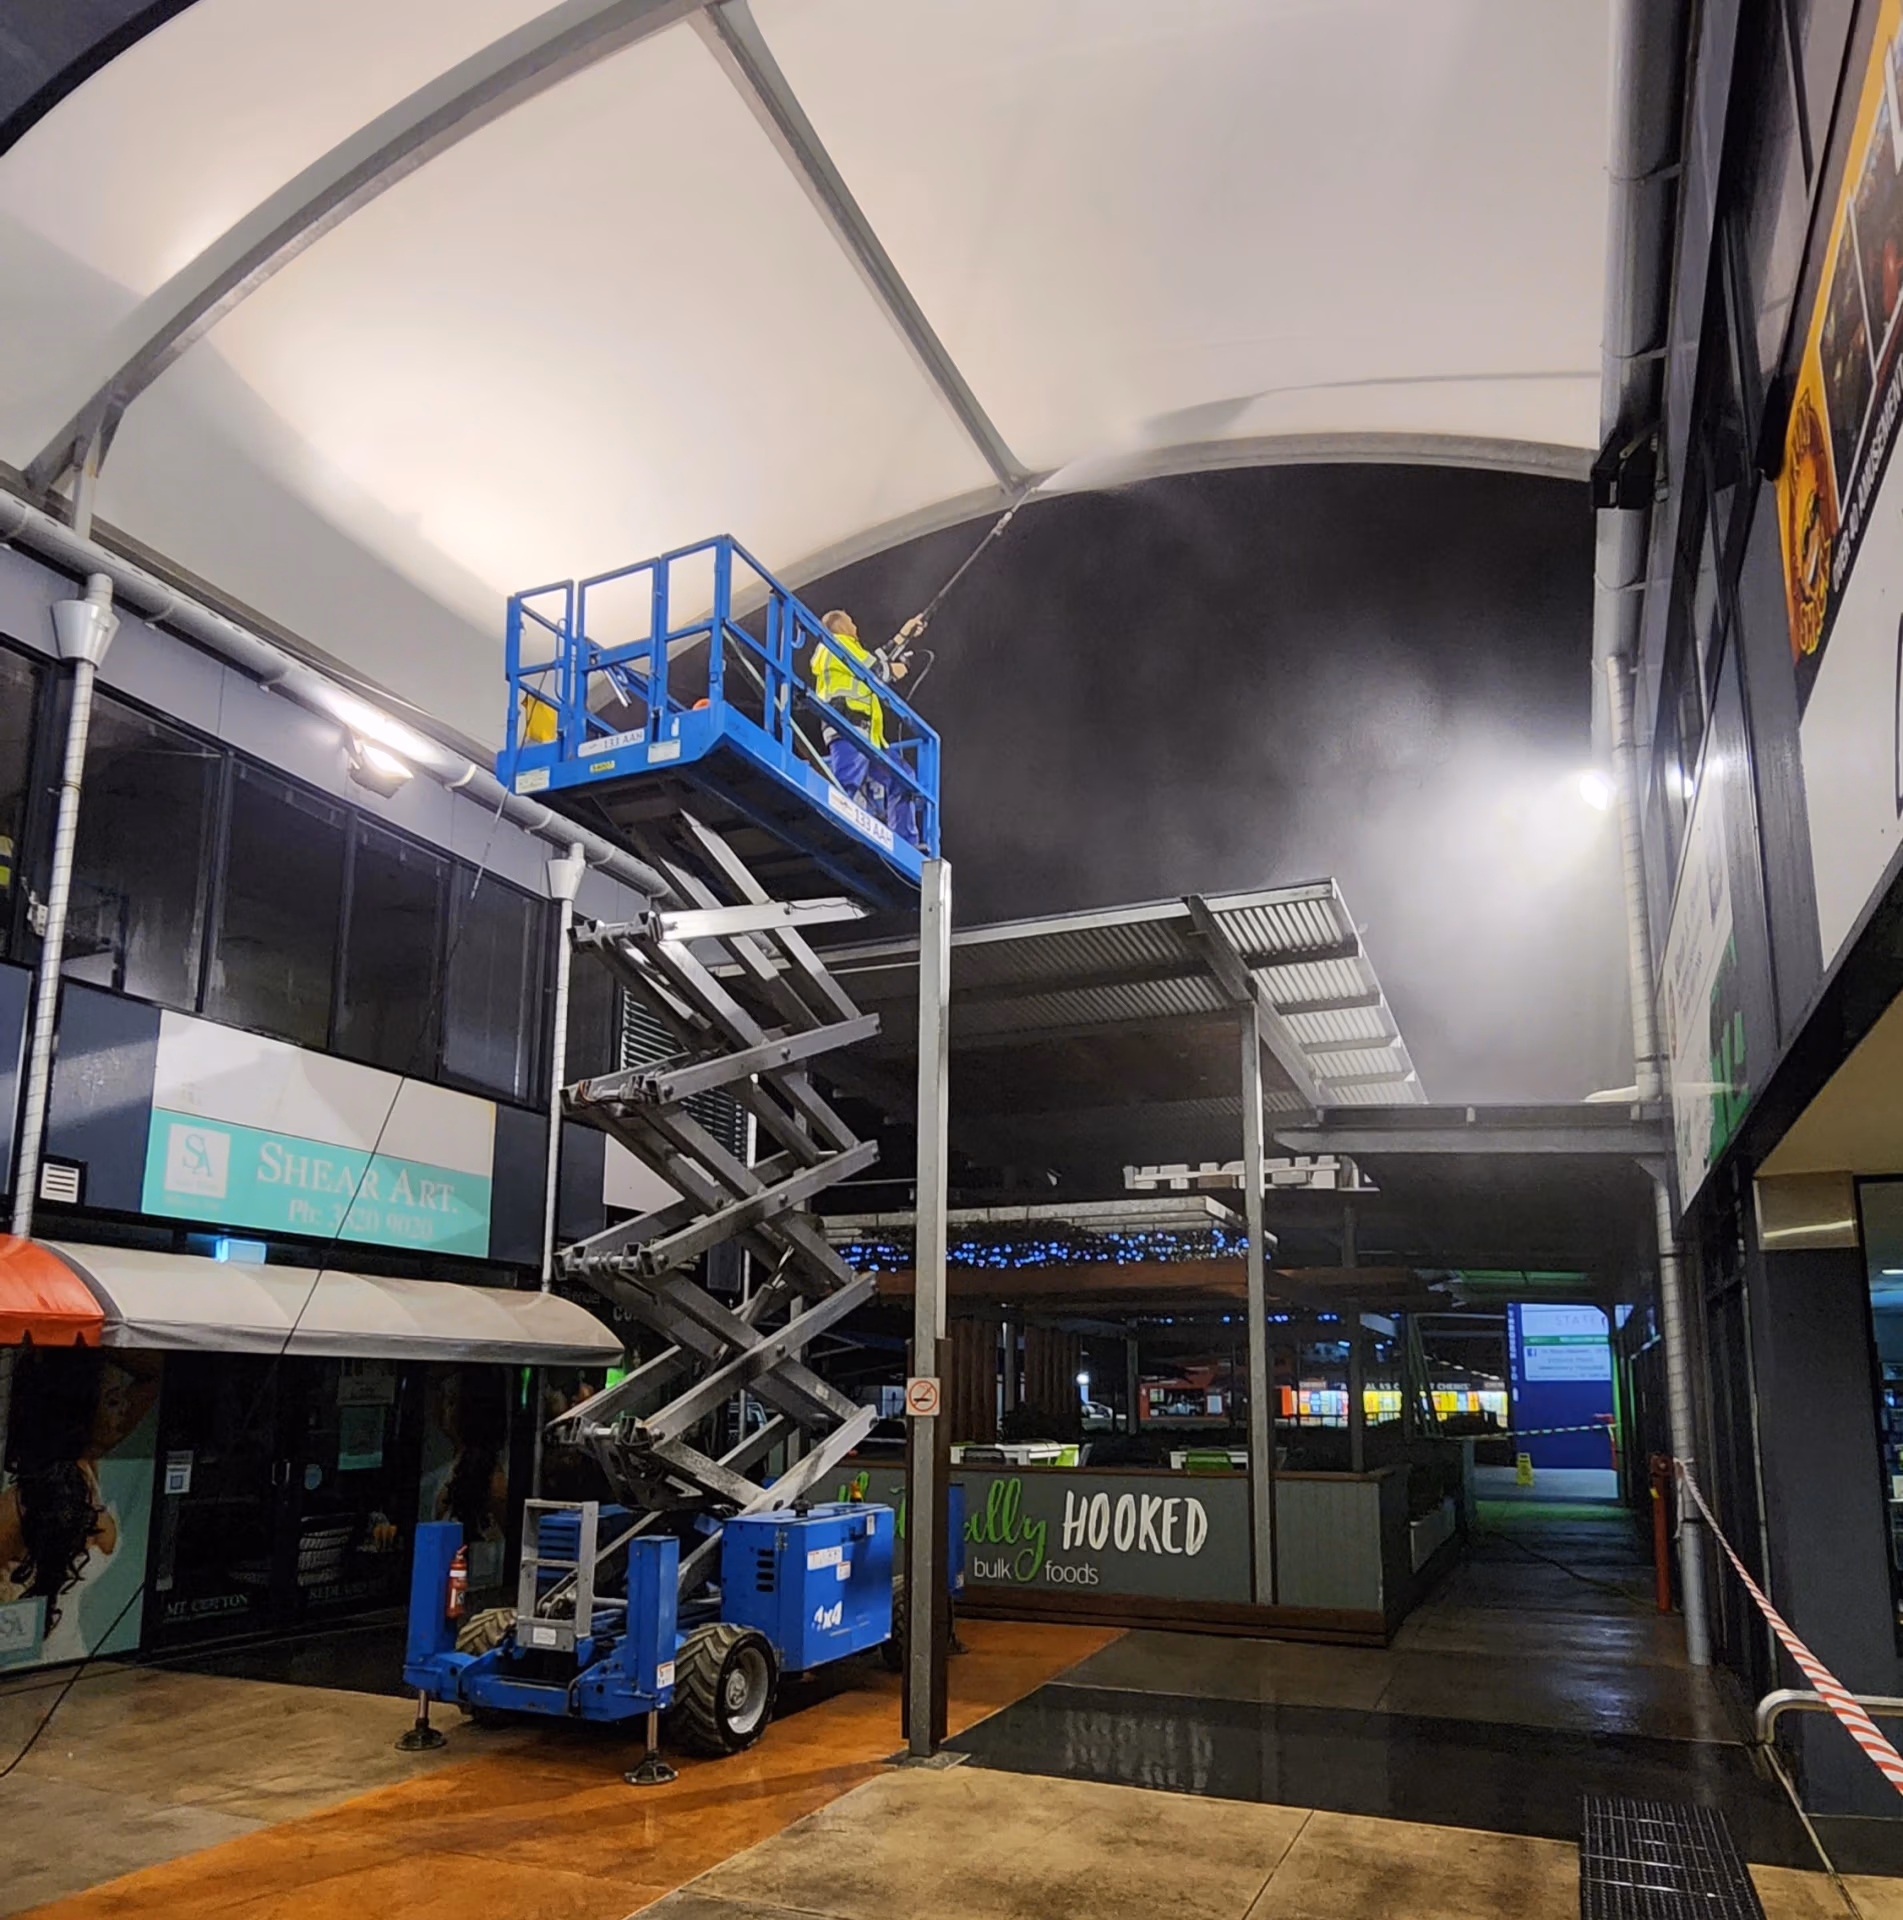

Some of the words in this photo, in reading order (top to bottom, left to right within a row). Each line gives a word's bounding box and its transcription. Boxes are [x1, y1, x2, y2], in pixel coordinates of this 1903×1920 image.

[256, 1141, 380, 1200] SHEAR
[1061, 1489, 1209, 1557] HOOKED
[973, 1556, 1012, 1580] bulk
[1044, 1559, 1100, 1586] foods
